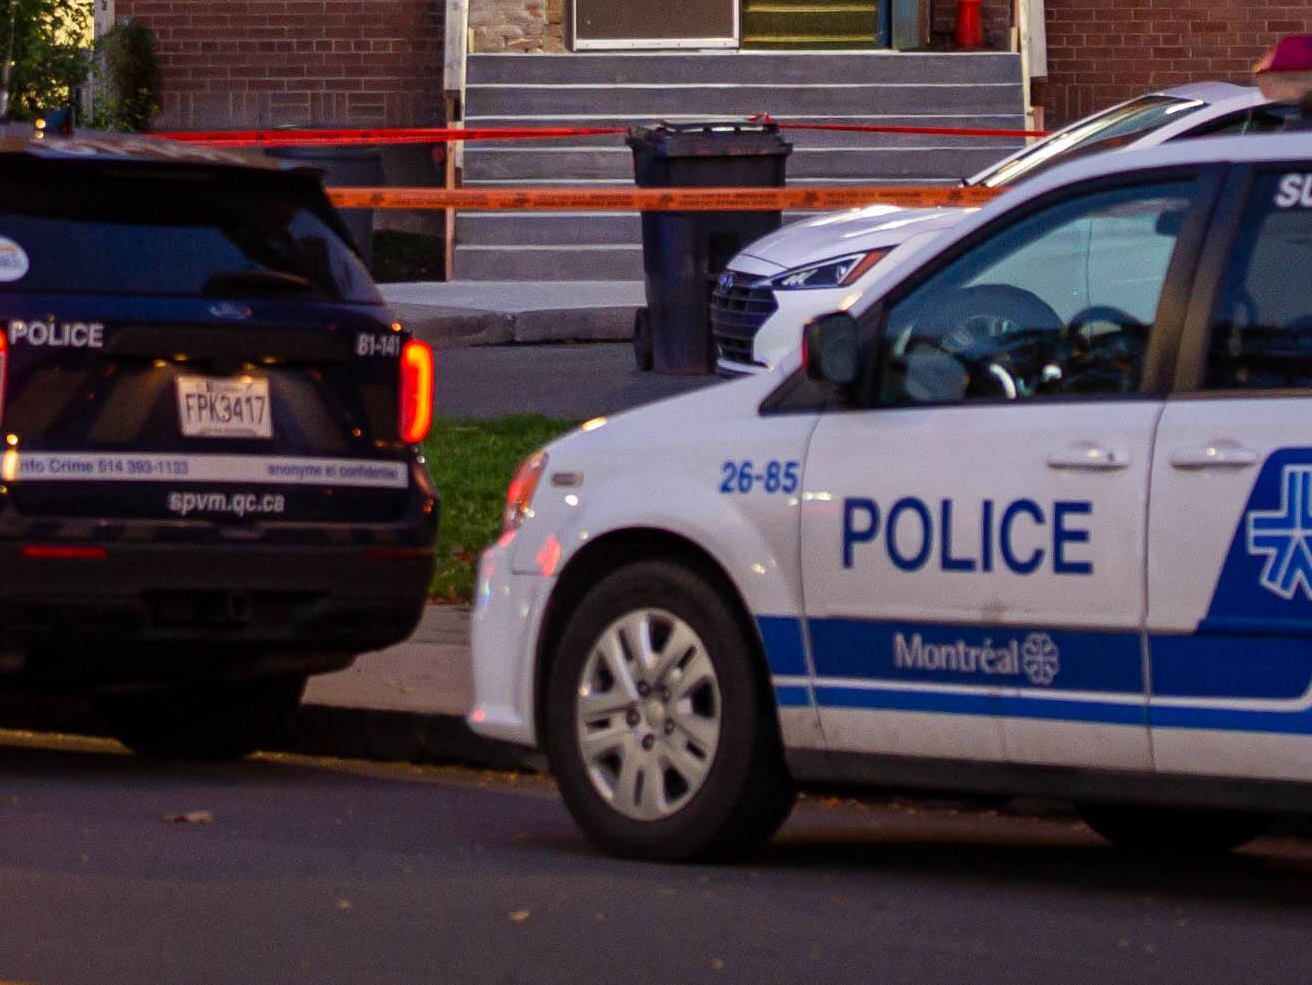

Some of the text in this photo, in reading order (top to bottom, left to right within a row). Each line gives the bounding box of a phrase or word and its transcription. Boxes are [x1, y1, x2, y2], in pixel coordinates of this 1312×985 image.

[9, 320, 104, 348] POLICE
[357, 333, 400, 357] 81-141
[185, 393, 267, 425] FPK3417
[50, 457, 94, 473] Crime
[267, 465, 322, 481] anonyme
[720, 460, 799, 494] 26-85
[168, 491, 285, 516] spvm.qc.ca
[841, 496, 1094, 576] POLICE
[893, 632, 1020, 675] Montréal
